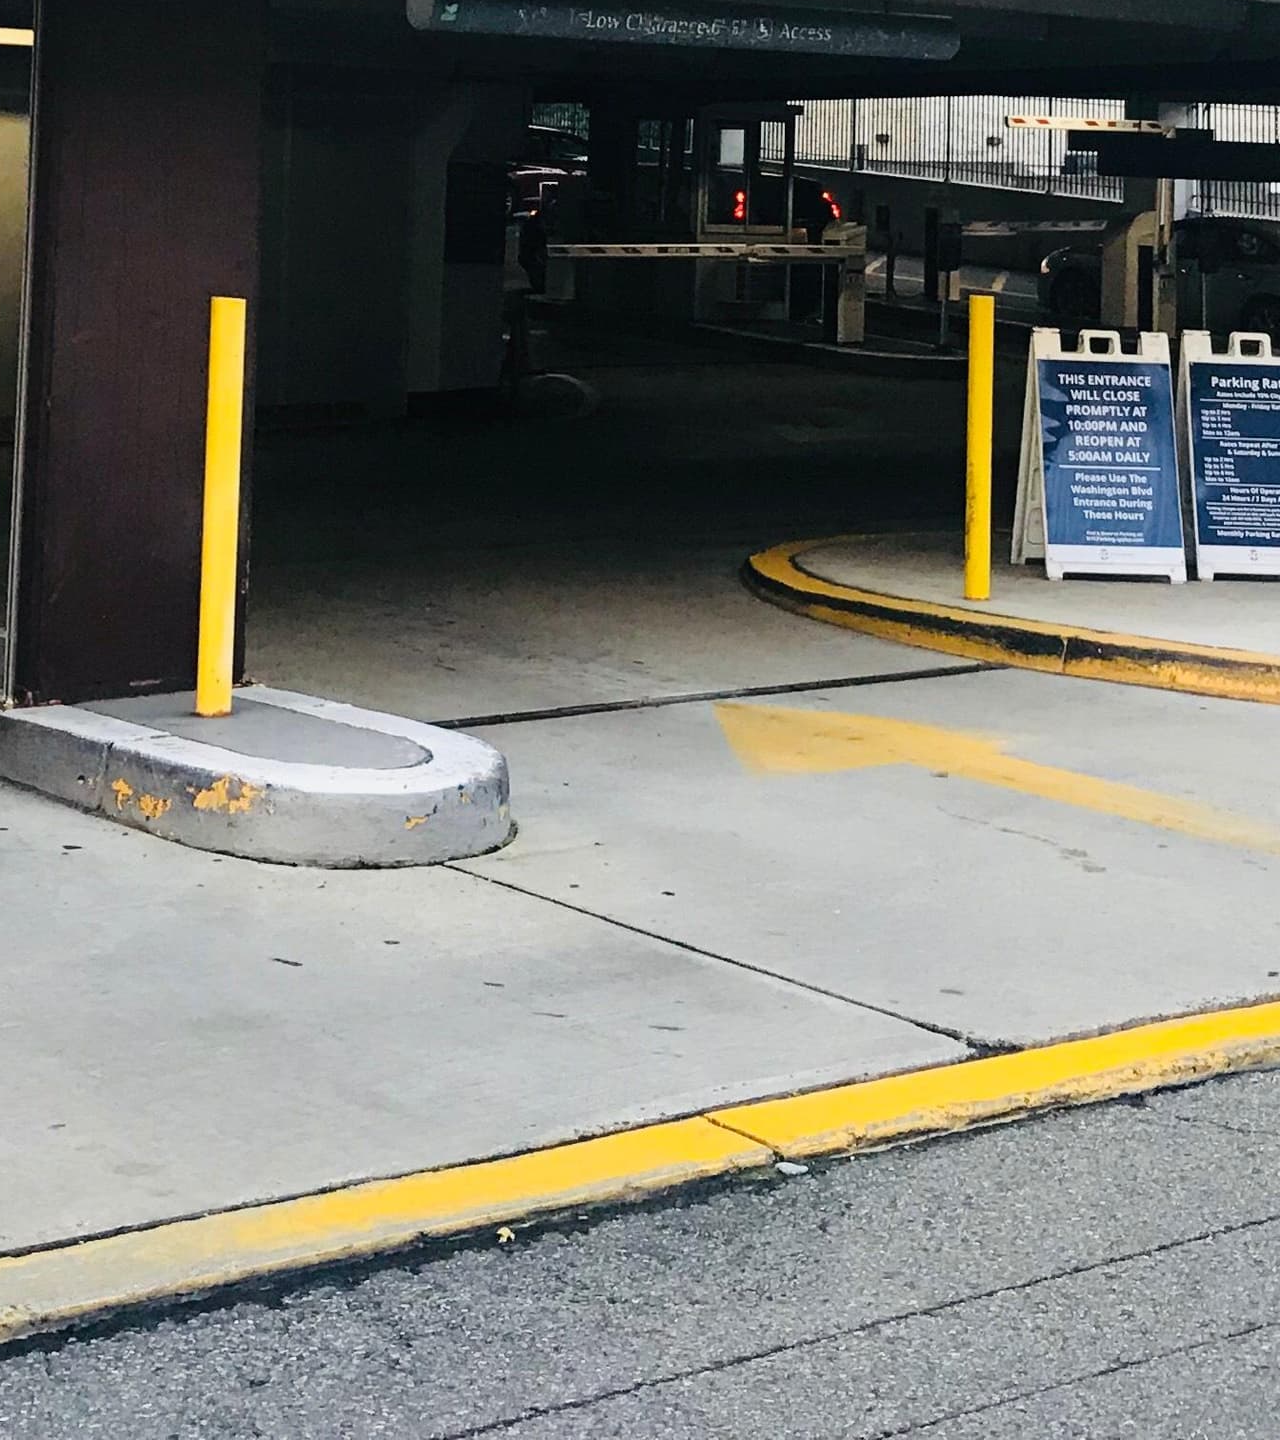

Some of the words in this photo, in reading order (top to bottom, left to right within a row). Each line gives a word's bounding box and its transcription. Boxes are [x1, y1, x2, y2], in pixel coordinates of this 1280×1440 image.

[779, 23, 832, 42] Access
[1057, 373, 1085, 385] THIS
[1088, 375, 1152, 387] ENTRANCE
[1210, 376, 1260, 391] Parking
[1070, 389, 1100, 401] WILL
[1103, 390, 1140, 402] CLOSE
[1065, 404, 1131, 416] PROMPTLY
[1132, 406, 1147, 417] AT
[1068, 420, 1117, 432] 10:00PM
[1120, 421, 1147, 432] AND
[1075, 435, 1124, 447] REOPEN
[1126, 437, 1141, 448] AT
[1068, 450, 1112, 462] 5:00AM
[1115, 452, 1150, 463] DAILY
[1074, 472, 1105, 483] Please
[1108, 473, 1128, 483] Use
[1128, 474, 1147, 484] The
[1070, 484, 1129, 497] Washington
[1131, 486, 1153, 496] Blvd
[1073, 497, 1117, 507] Entrance
[1119, 498, 1153, 511] During
[1261, 496, 1277, 504] Days
[1083, 510, 1113, 520] These
[1114, 511, 1144, 521] Hours
[1245, 530, 1270, 539] Parking
